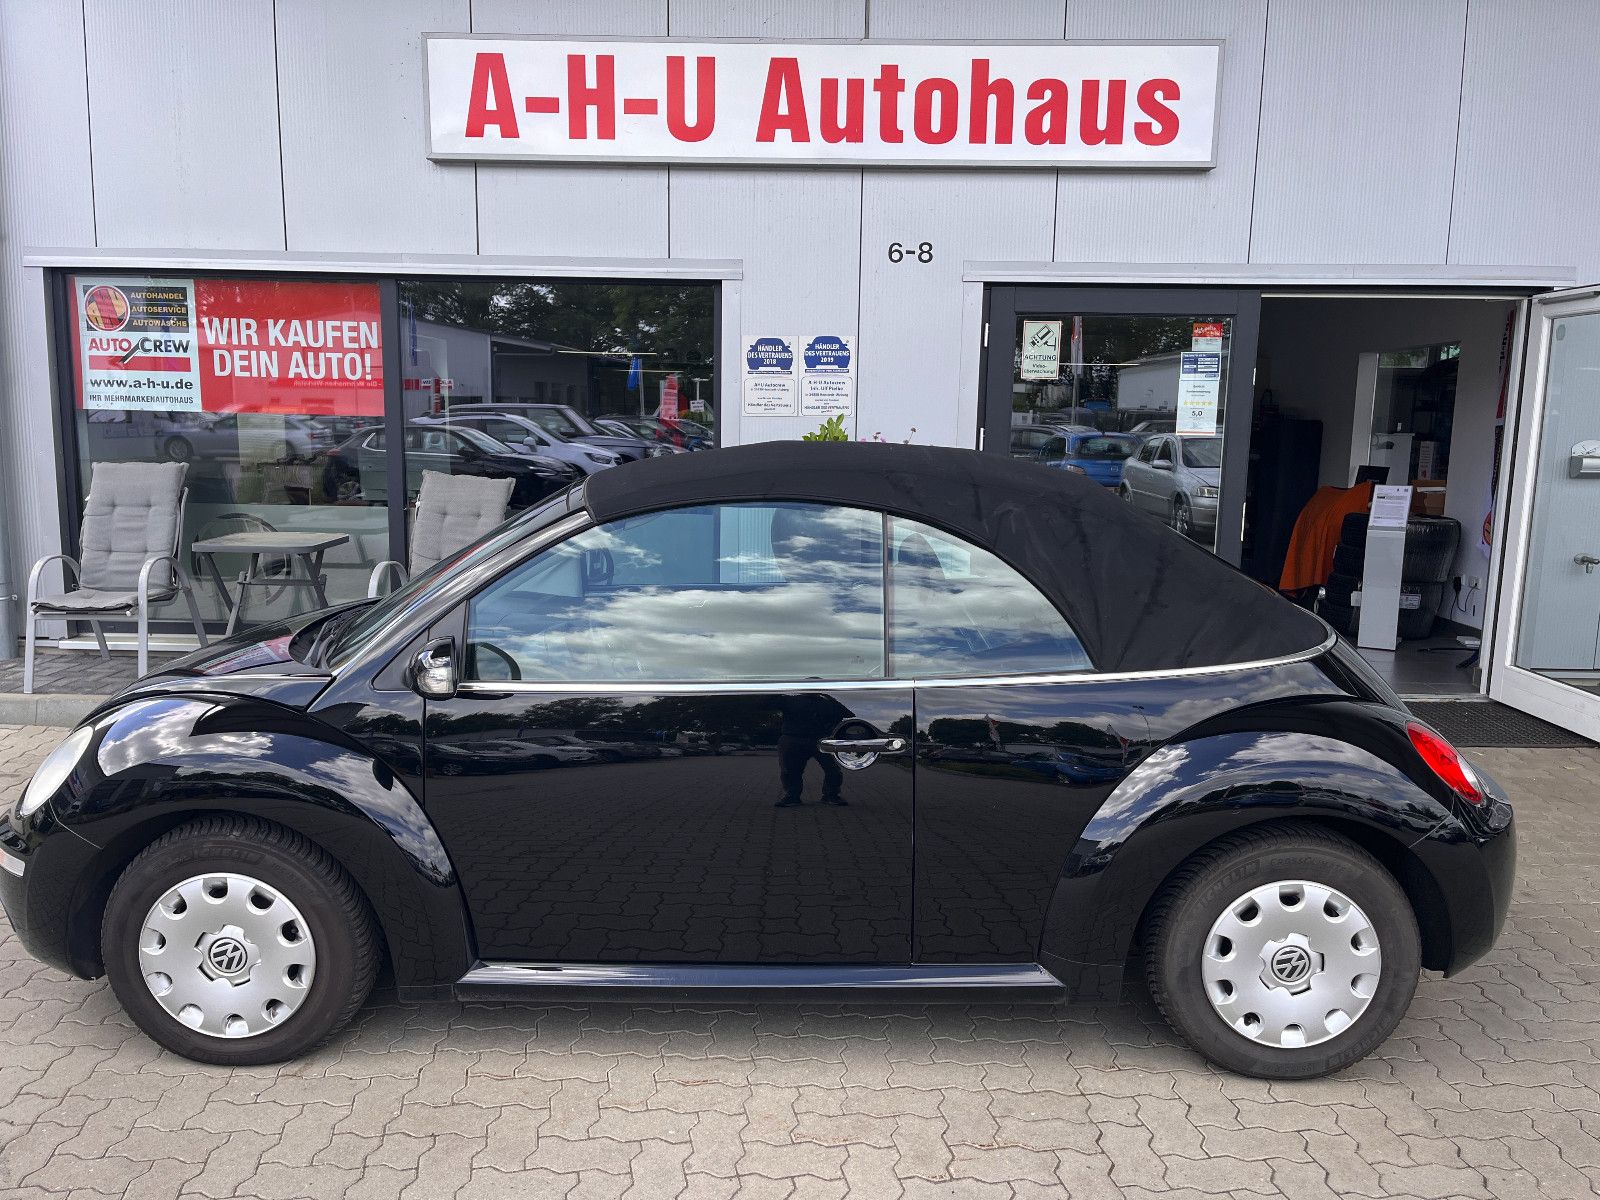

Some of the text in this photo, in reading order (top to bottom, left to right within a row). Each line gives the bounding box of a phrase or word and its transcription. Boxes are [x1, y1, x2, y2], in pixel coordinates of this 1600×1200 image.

[464, 53, 1180, 146] A-H-U Autohaus
[888, 242, 933, 263] 6-8
[130, 292, 184, 300] AUTOHANDEL
[132, 305, 187, 314] AUTOSERVICE
[202, 317, 378, 349] WIR KAUFEN
[758, 344, 782, 352] HÄNDLER
[213, 350, 372, 380] DEIN AUTO!
[90, 378, 193, 390] www.a-h-u.de
[90, 394, 194, 404] IHR MEHRMARKENAUTOHAUS
